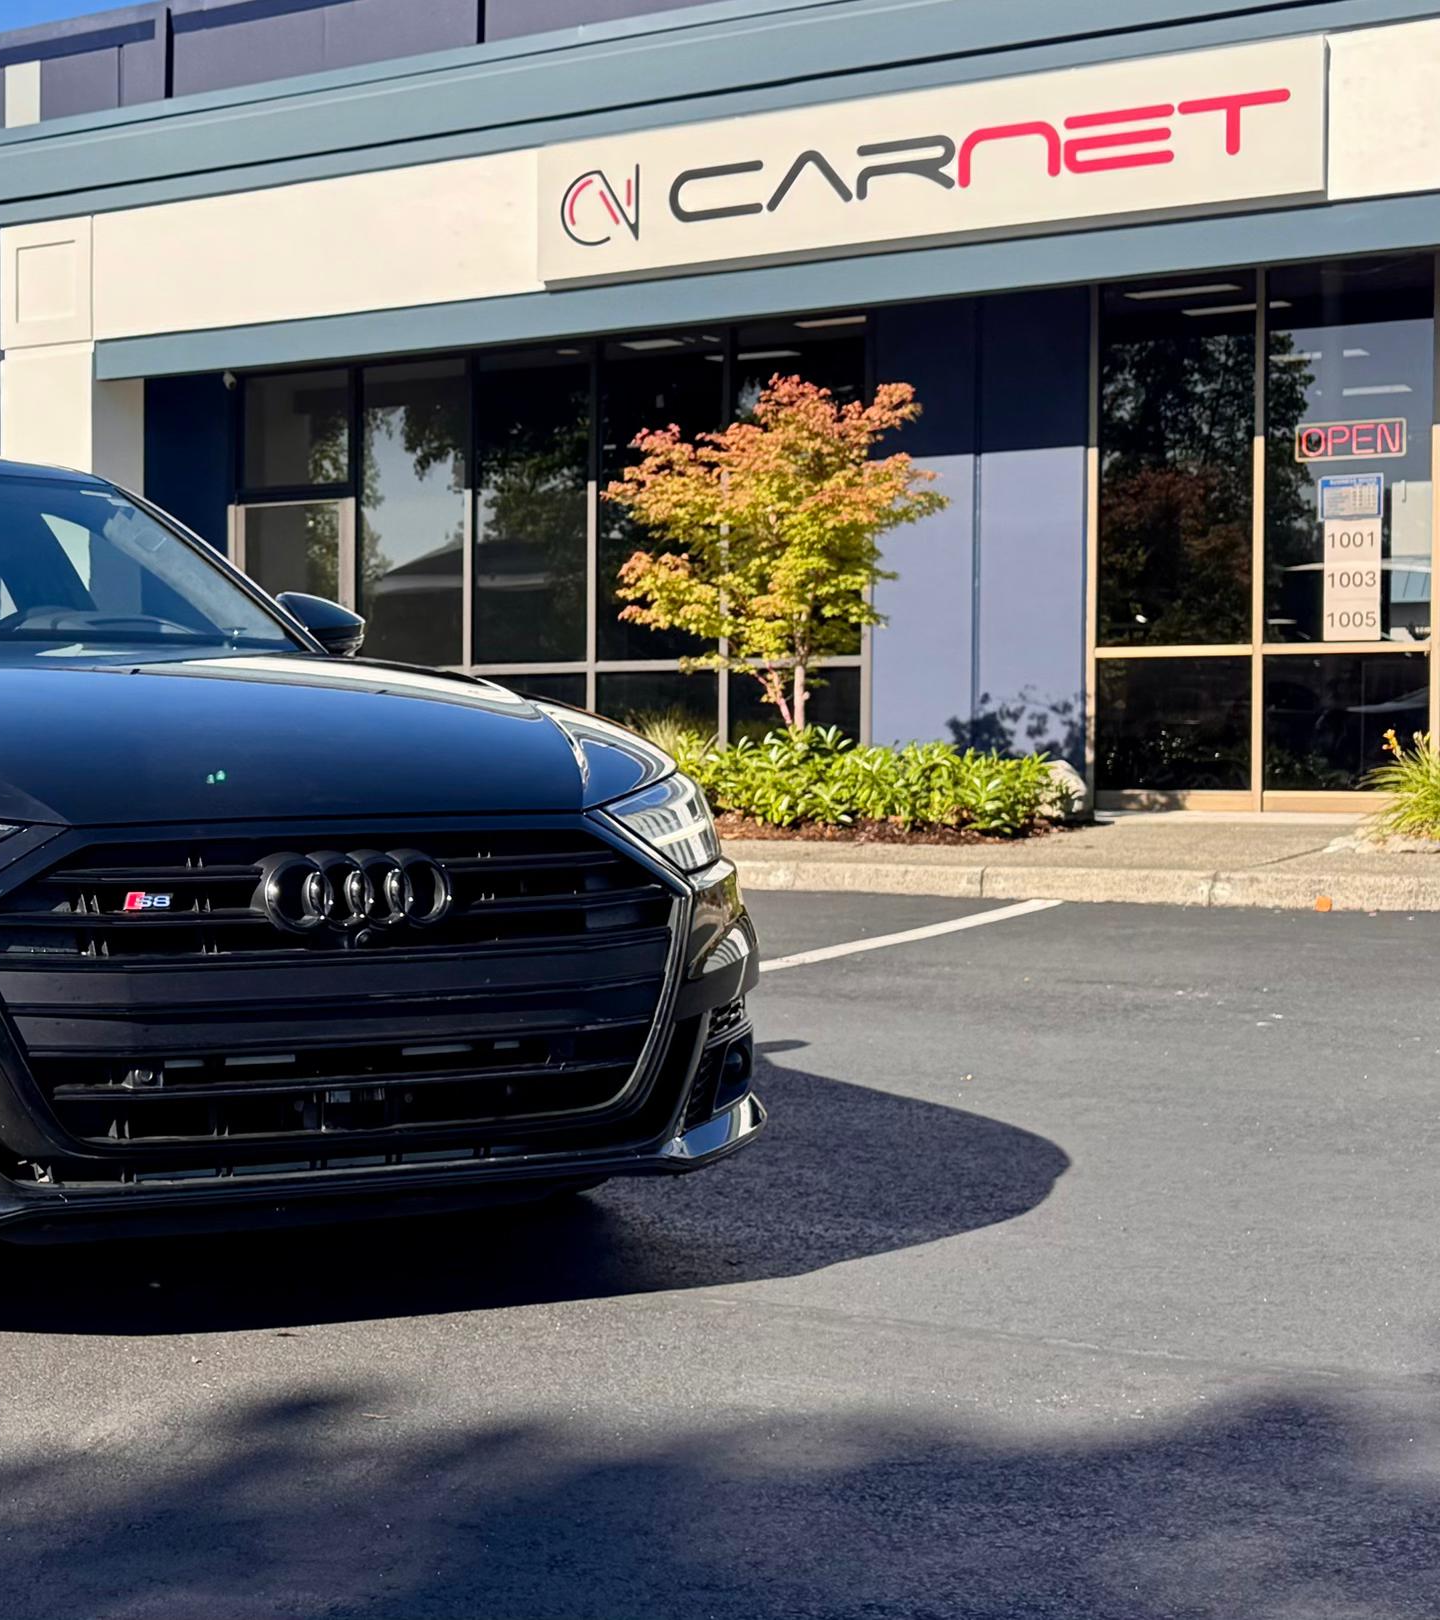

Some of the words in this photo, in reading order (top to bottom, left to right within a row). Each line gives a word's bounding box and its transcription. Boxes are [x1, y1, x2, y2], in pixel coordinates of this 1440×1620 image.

[668, 87, 1291, 223] CARNET
[1301, 423, 1400, 457] OPEN
[1327, 531, 1376, 549] 1001
[1327, 571, 1377, 589] 1003
[1326, 611, 1378, 629] 1005
[134, 894, 170, 908] S8
